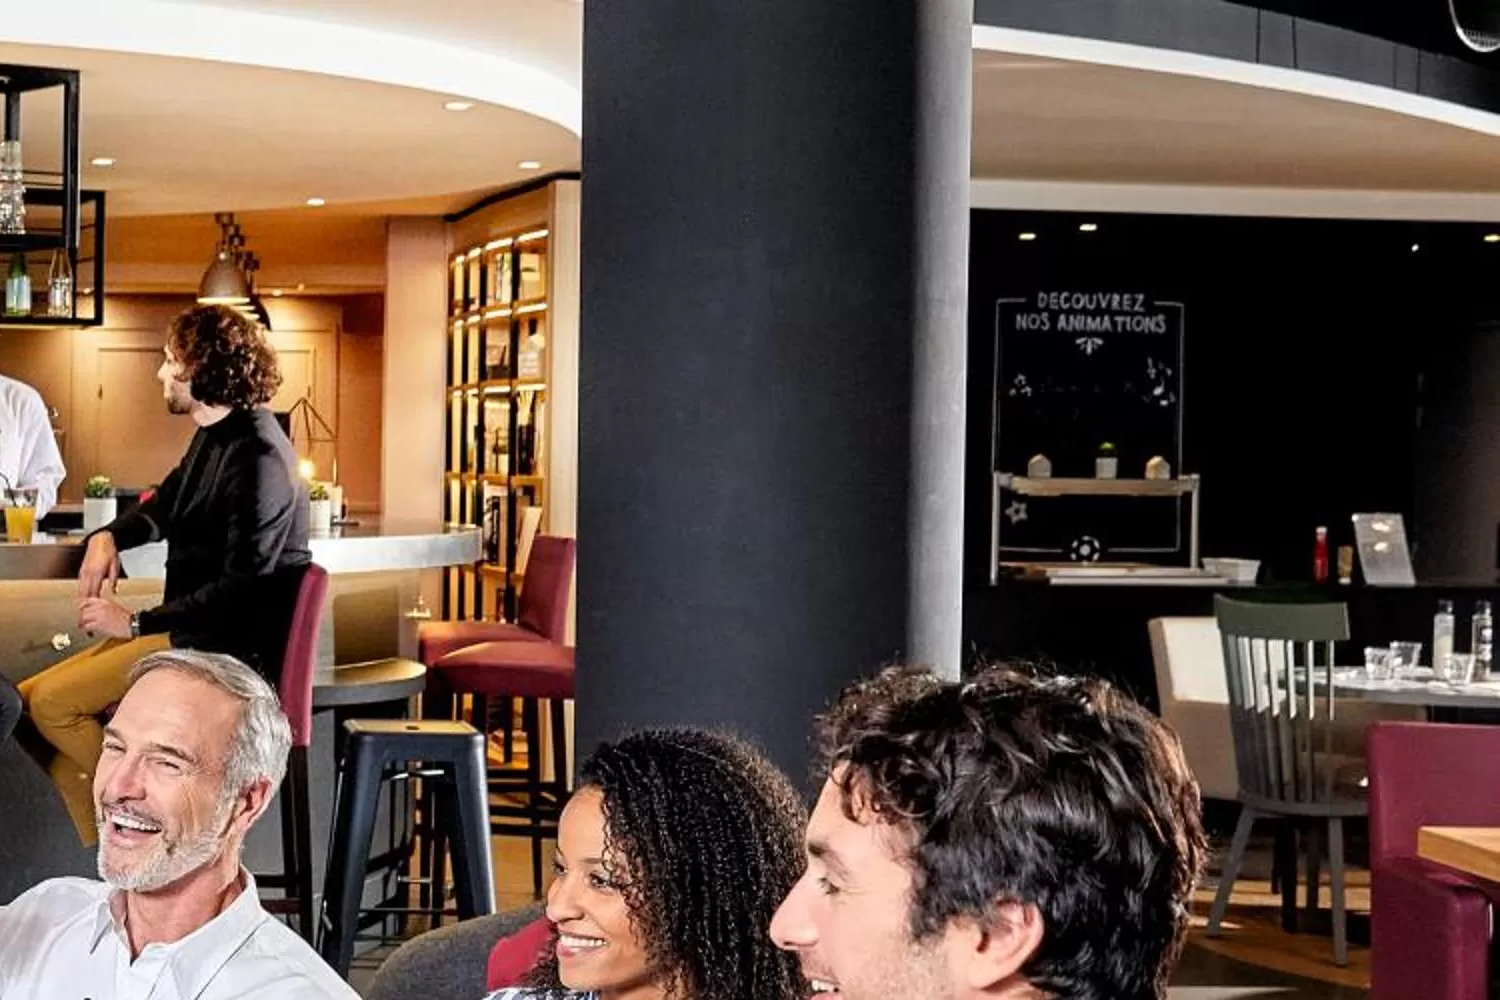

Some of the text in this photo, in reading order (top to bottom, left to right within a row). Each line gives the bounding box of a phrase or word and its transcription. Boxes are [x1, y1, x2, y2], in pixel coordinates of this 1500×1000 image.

[1037, 291, 1145, 312] DECOUVREZ
[1015, 312, 1167, 333] NOS ANIMATIONS
